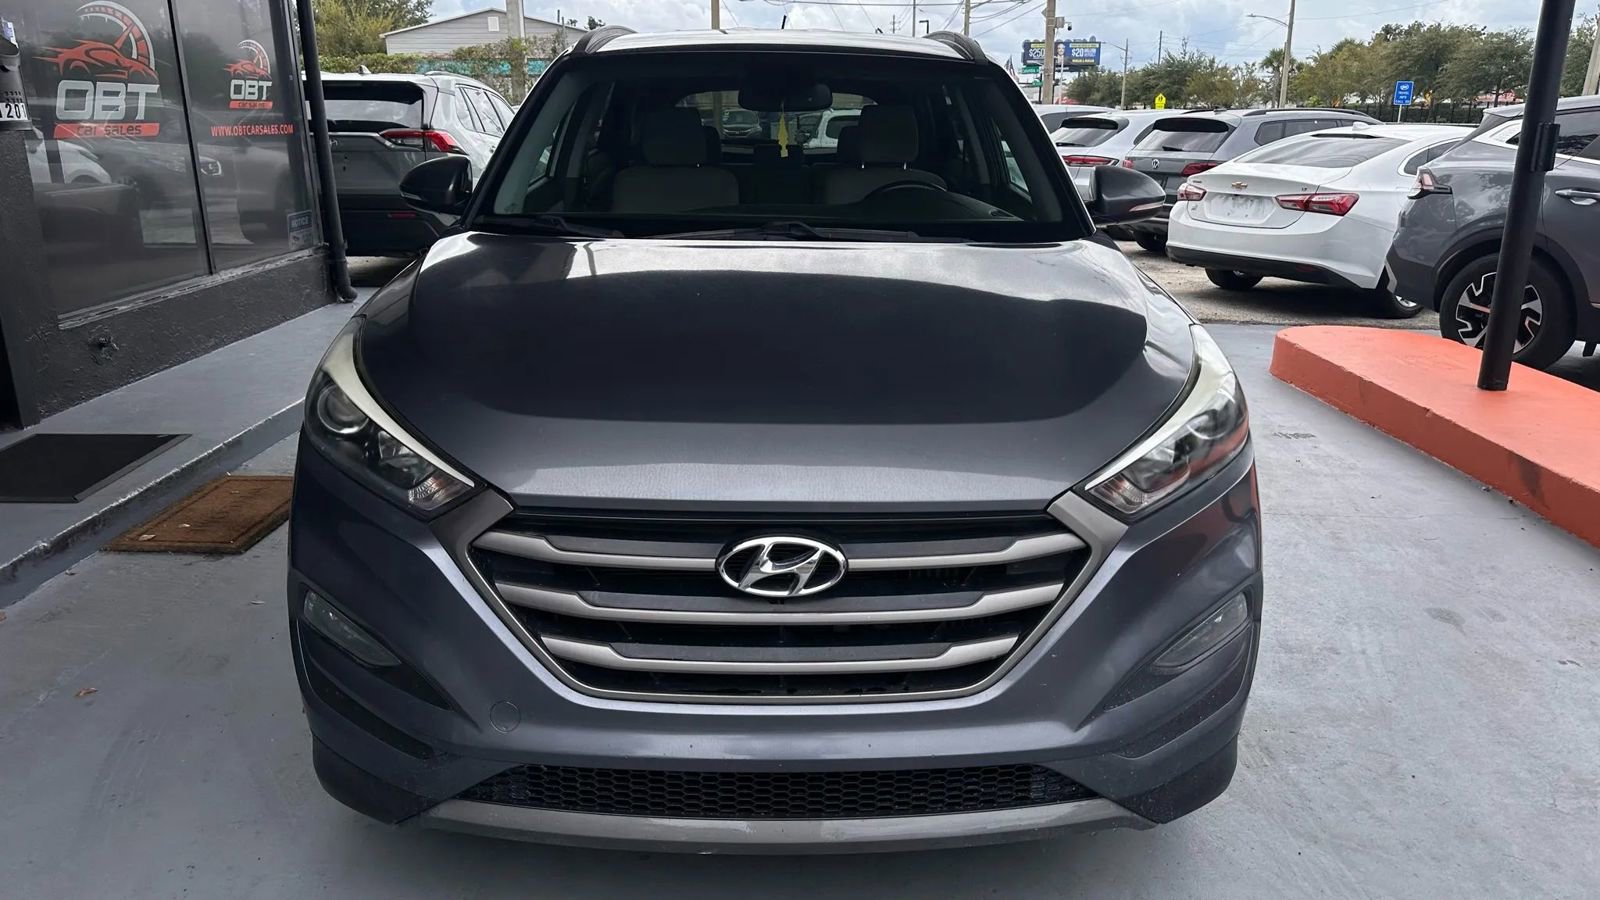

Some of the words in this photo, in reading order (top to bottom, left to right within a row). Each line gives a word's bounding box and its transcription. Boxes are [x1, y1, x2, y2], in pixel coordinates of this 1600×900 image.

[56, 80, 160, 120] OBT
[230, 79, 272, 100] OBT
[210, 124, 294, 136] WWW.OBTCARSALES.COM
